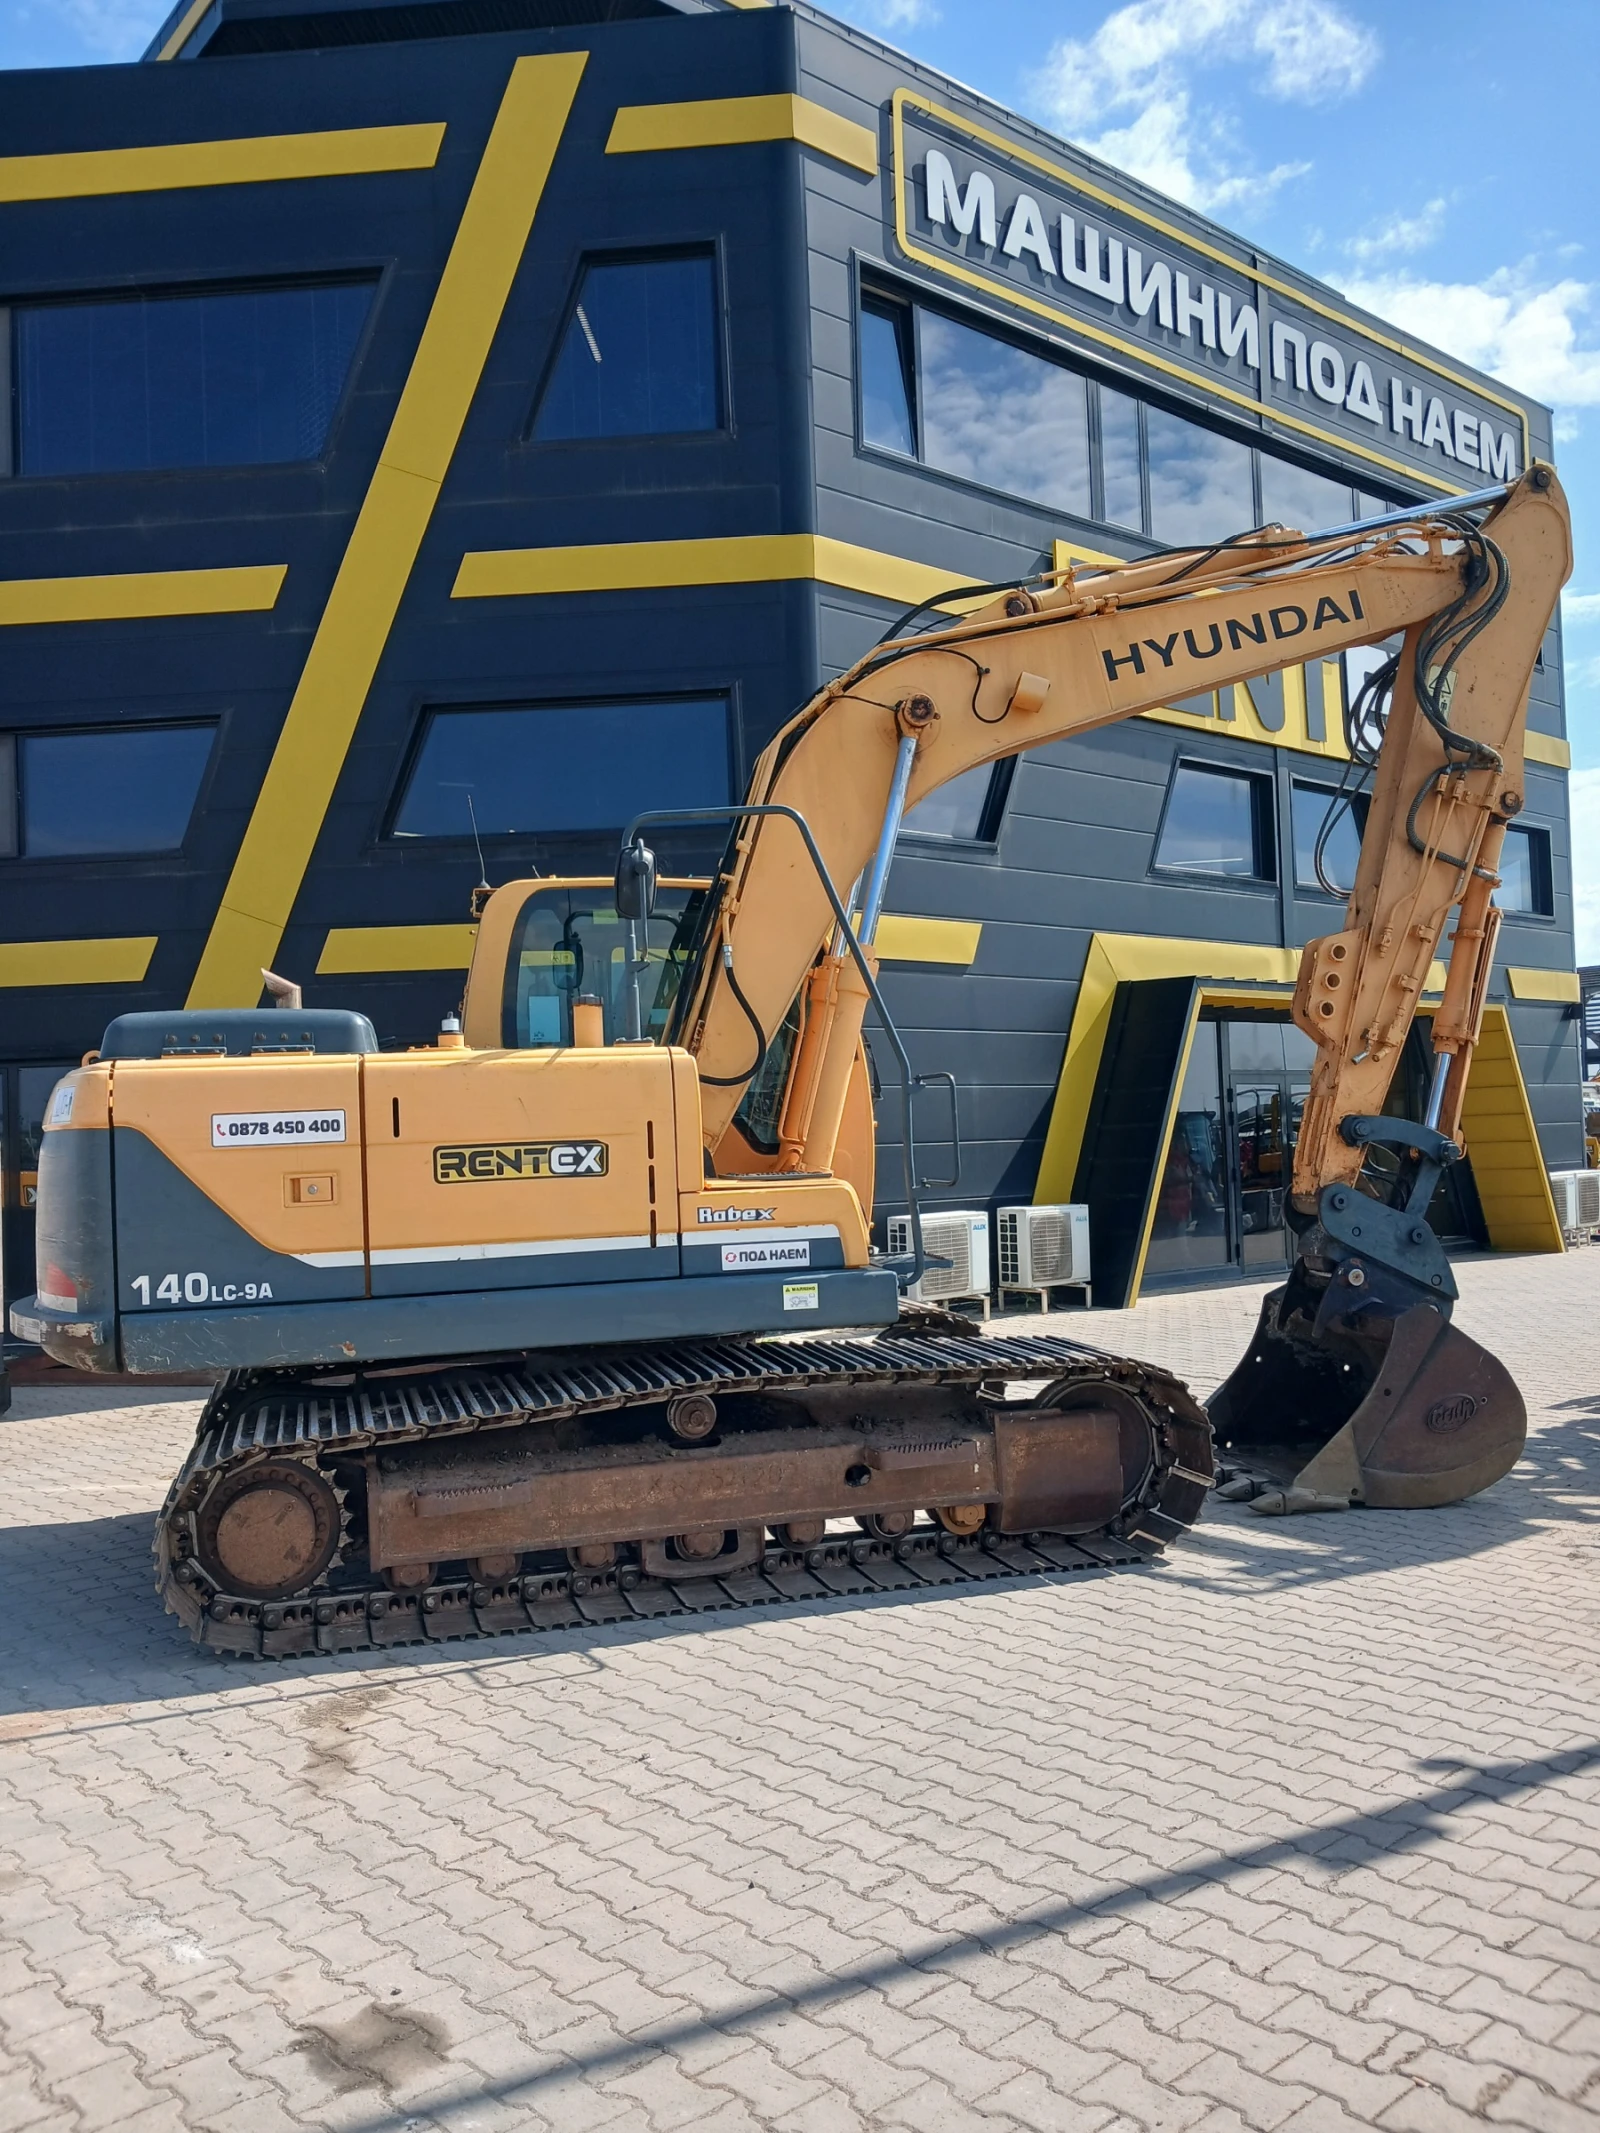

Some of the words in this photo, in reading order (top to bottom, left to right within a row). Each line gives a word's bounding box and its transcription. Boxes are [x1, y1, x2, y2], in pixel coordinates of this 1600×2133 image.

[926, 149, 1260, 369] МАШИНИ
[1272, 320, 1383, 425] ПОД
[1391, 376, 1516, 484] НАЕМ
[1102, 590, 1365, 682] HYUNDAI
[229, 1122, 269, 1136] 0878
[273, 1120, 305, 1134] 450
[308, 1119, 341, 1132] 400
[440, 1146, 602, 1179] RENTEX
[972, 1223, 987, 1231] AUX
[739, 1250, 767, 1262] ПОД
[769, 1248, 807, 1261] НАЕМ
